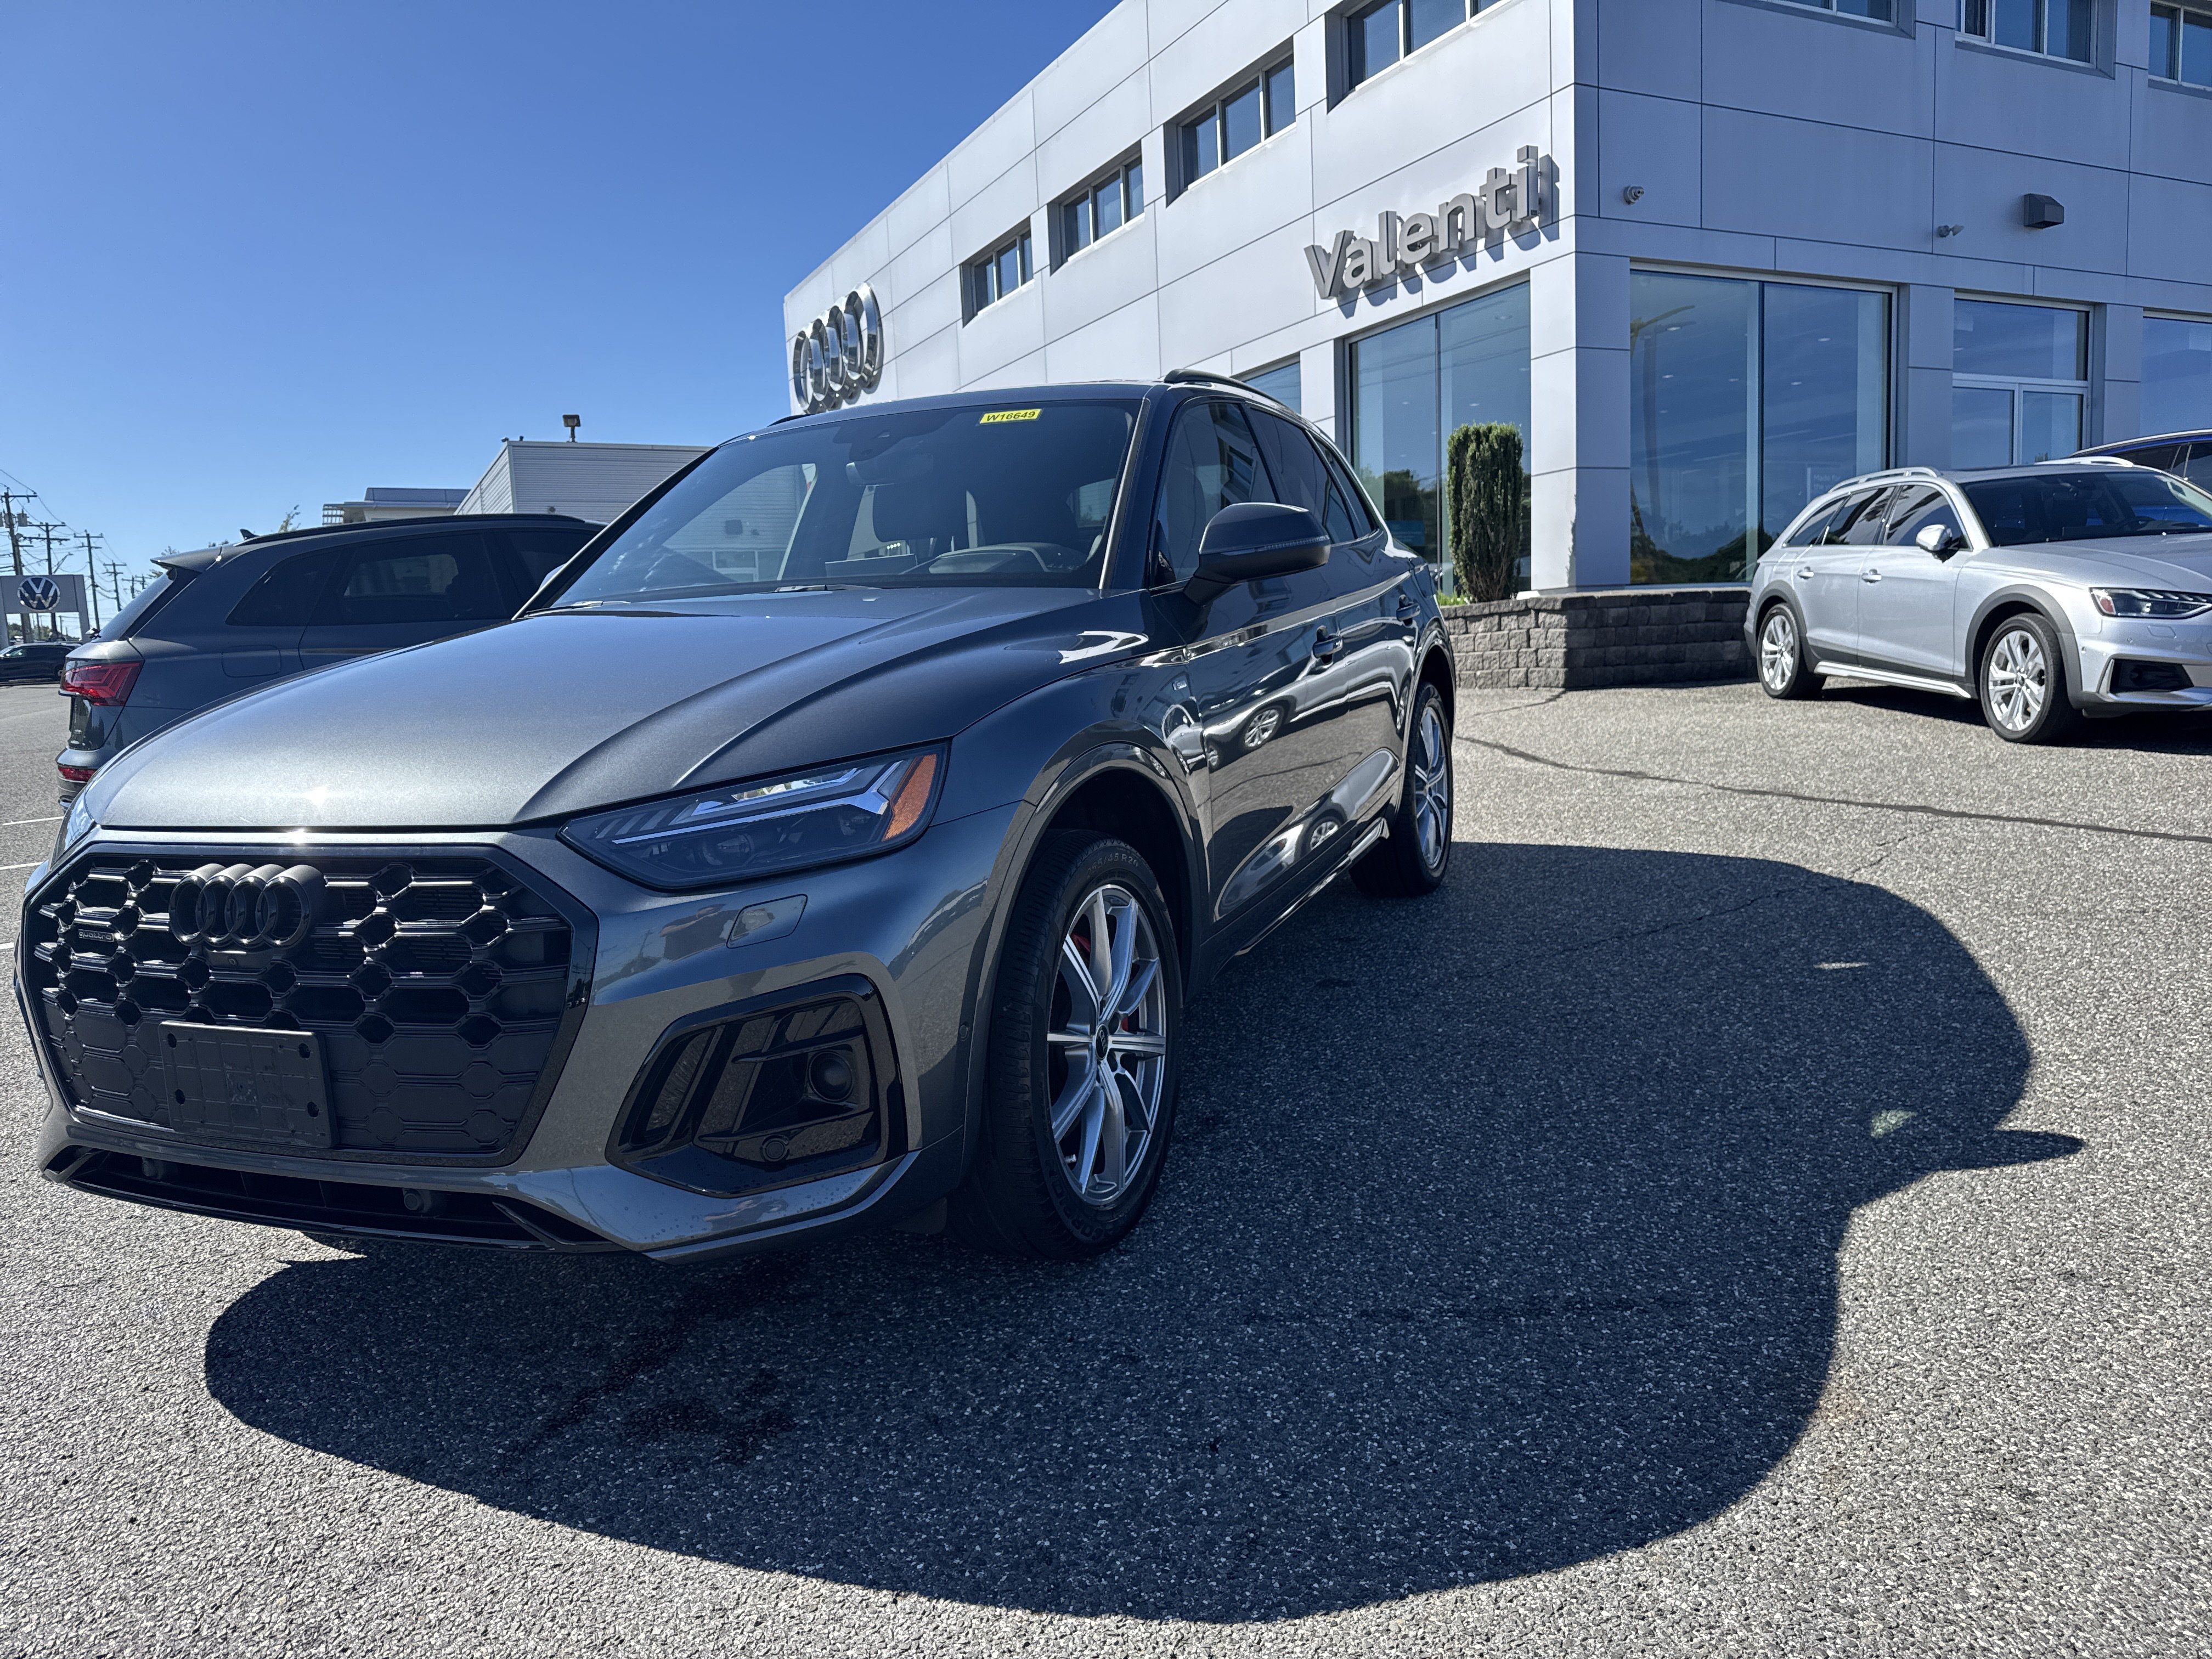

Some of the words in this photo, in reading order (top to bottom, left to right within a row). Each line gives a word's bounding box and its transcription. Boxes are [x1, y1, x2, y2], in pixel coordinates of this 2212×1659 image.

[1304, 145, 1538, 300] Valenti
[986, 411, 1036, 421] W16649
[78, 932, 111, 940] quattro
